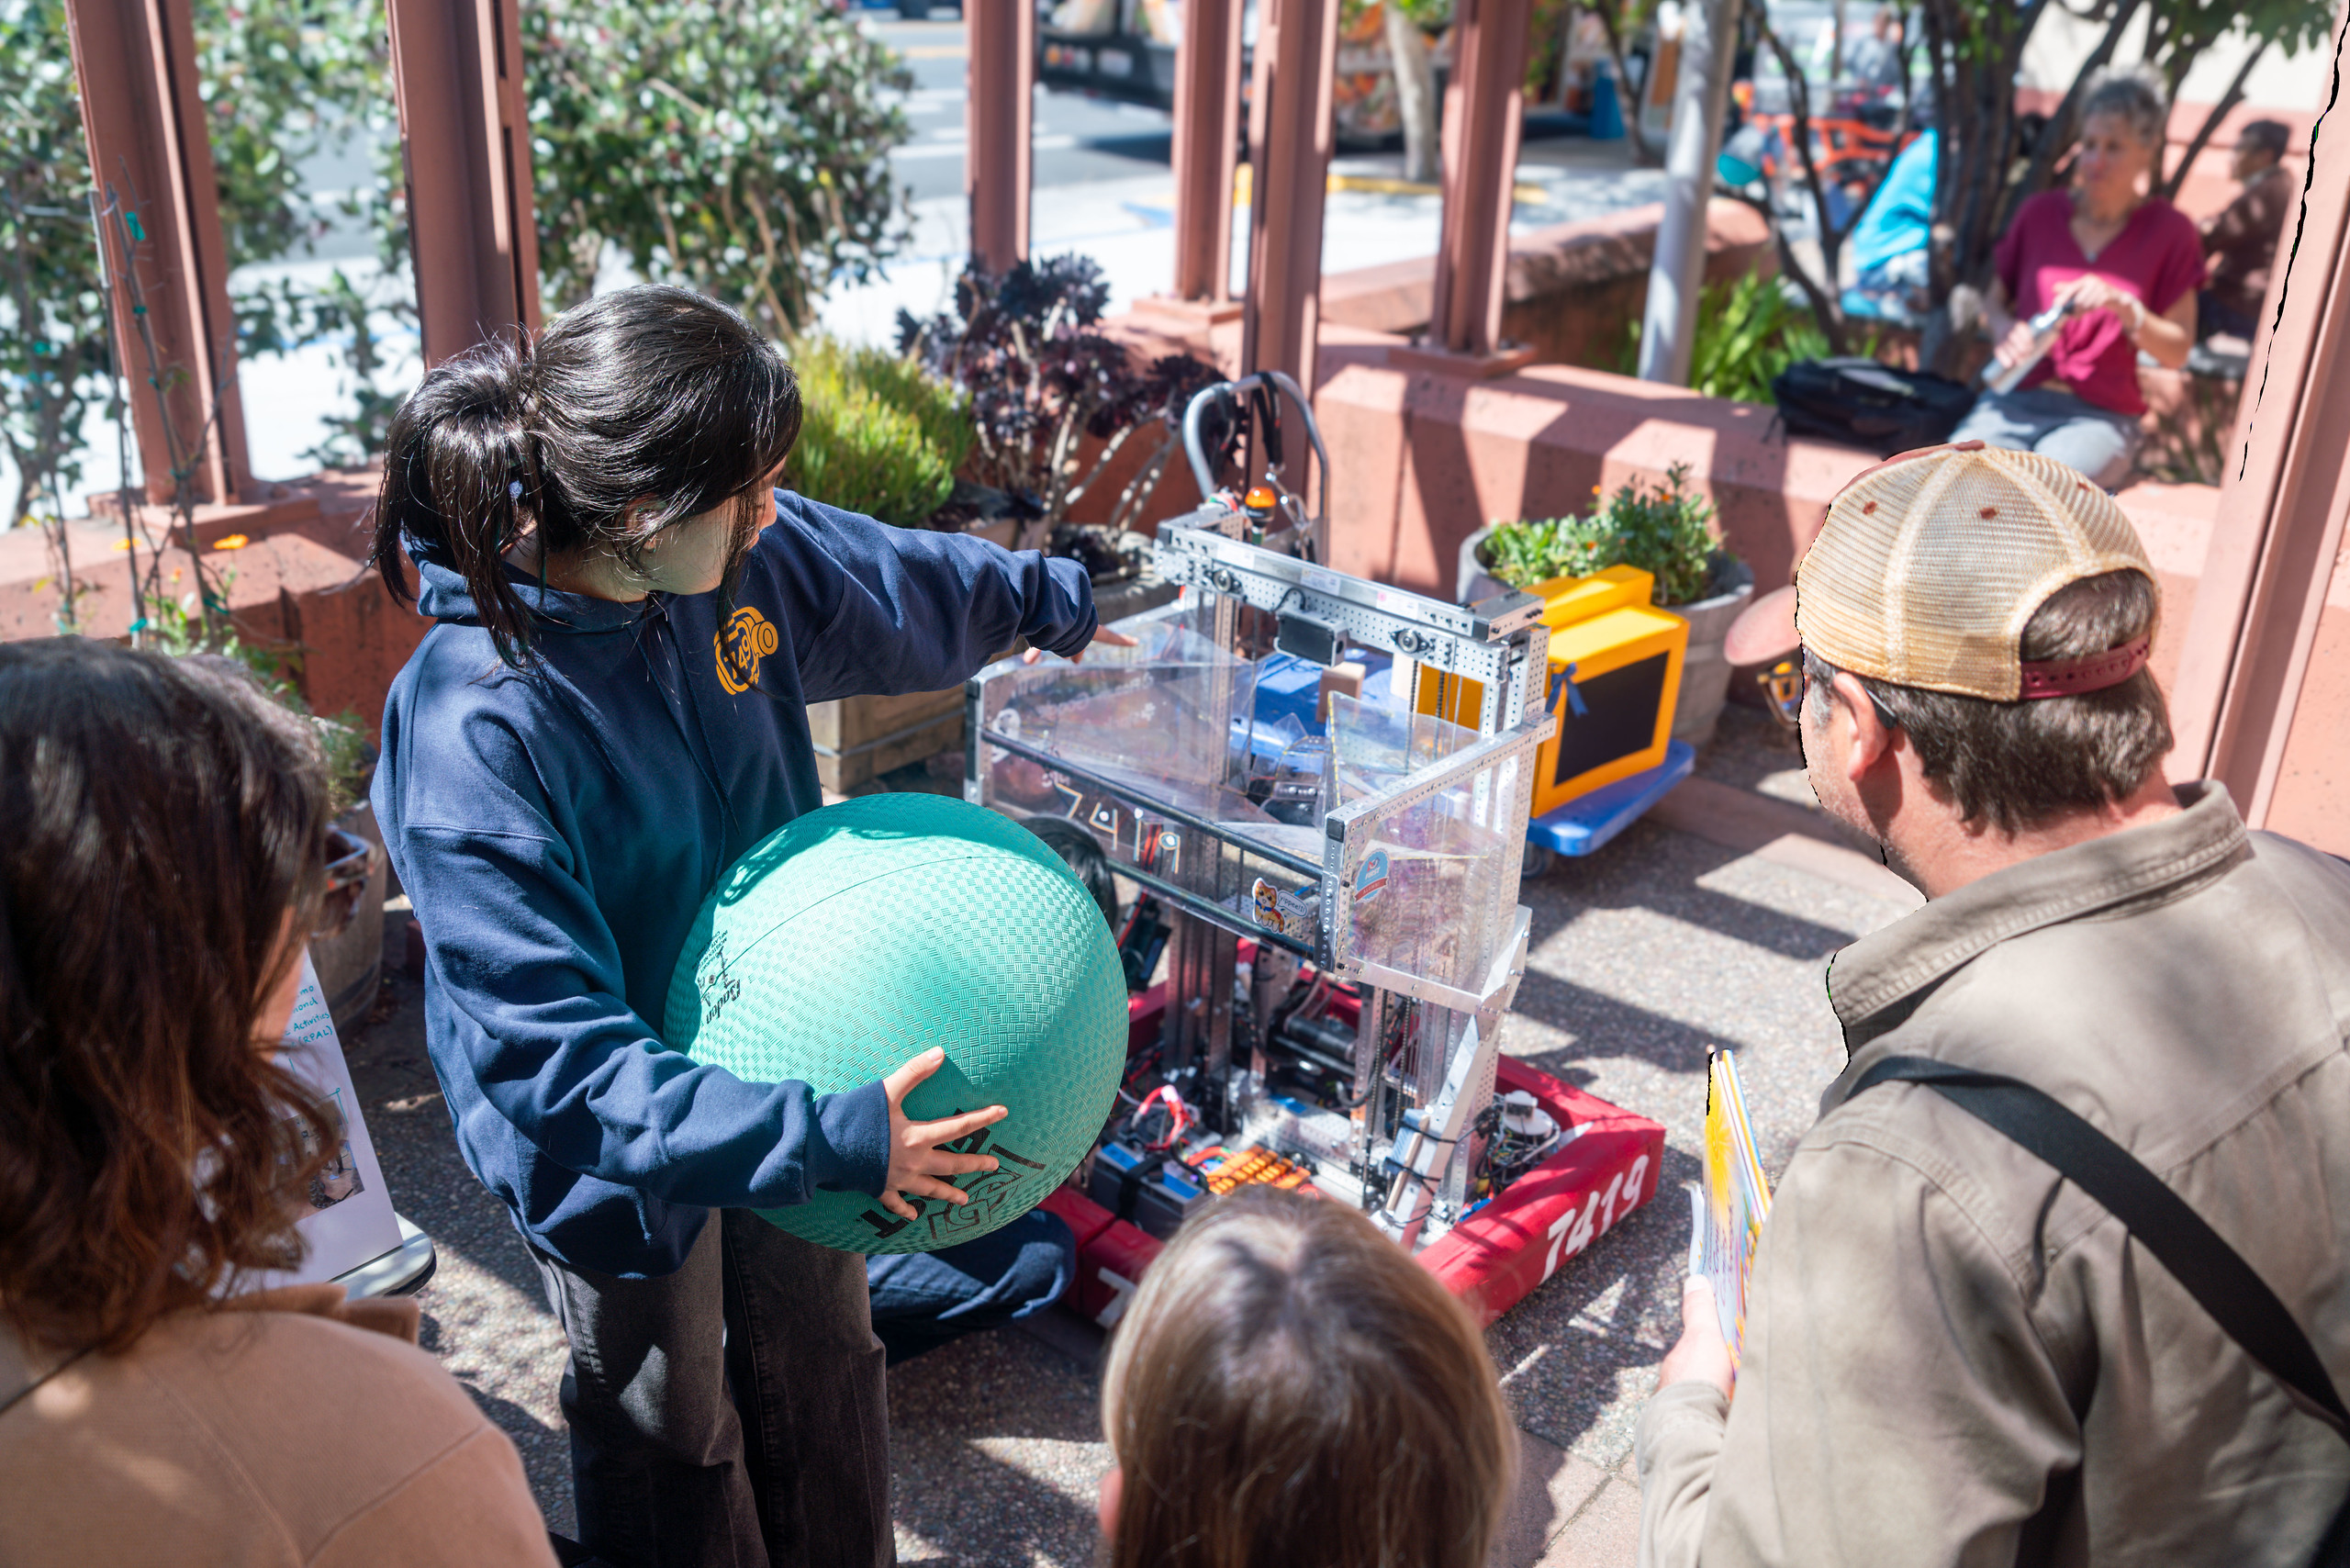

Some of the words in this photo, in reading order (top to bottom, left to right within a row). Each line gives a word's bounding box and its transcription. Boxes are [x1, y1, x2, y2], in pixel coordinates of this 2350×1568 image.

[1056, 782, 1181, 874] 7419
[294, 1012, 330, 1032] Activities
[706, 979, 741, 1025] Baden
[1539, 1154, 1650, 1285] 7419
